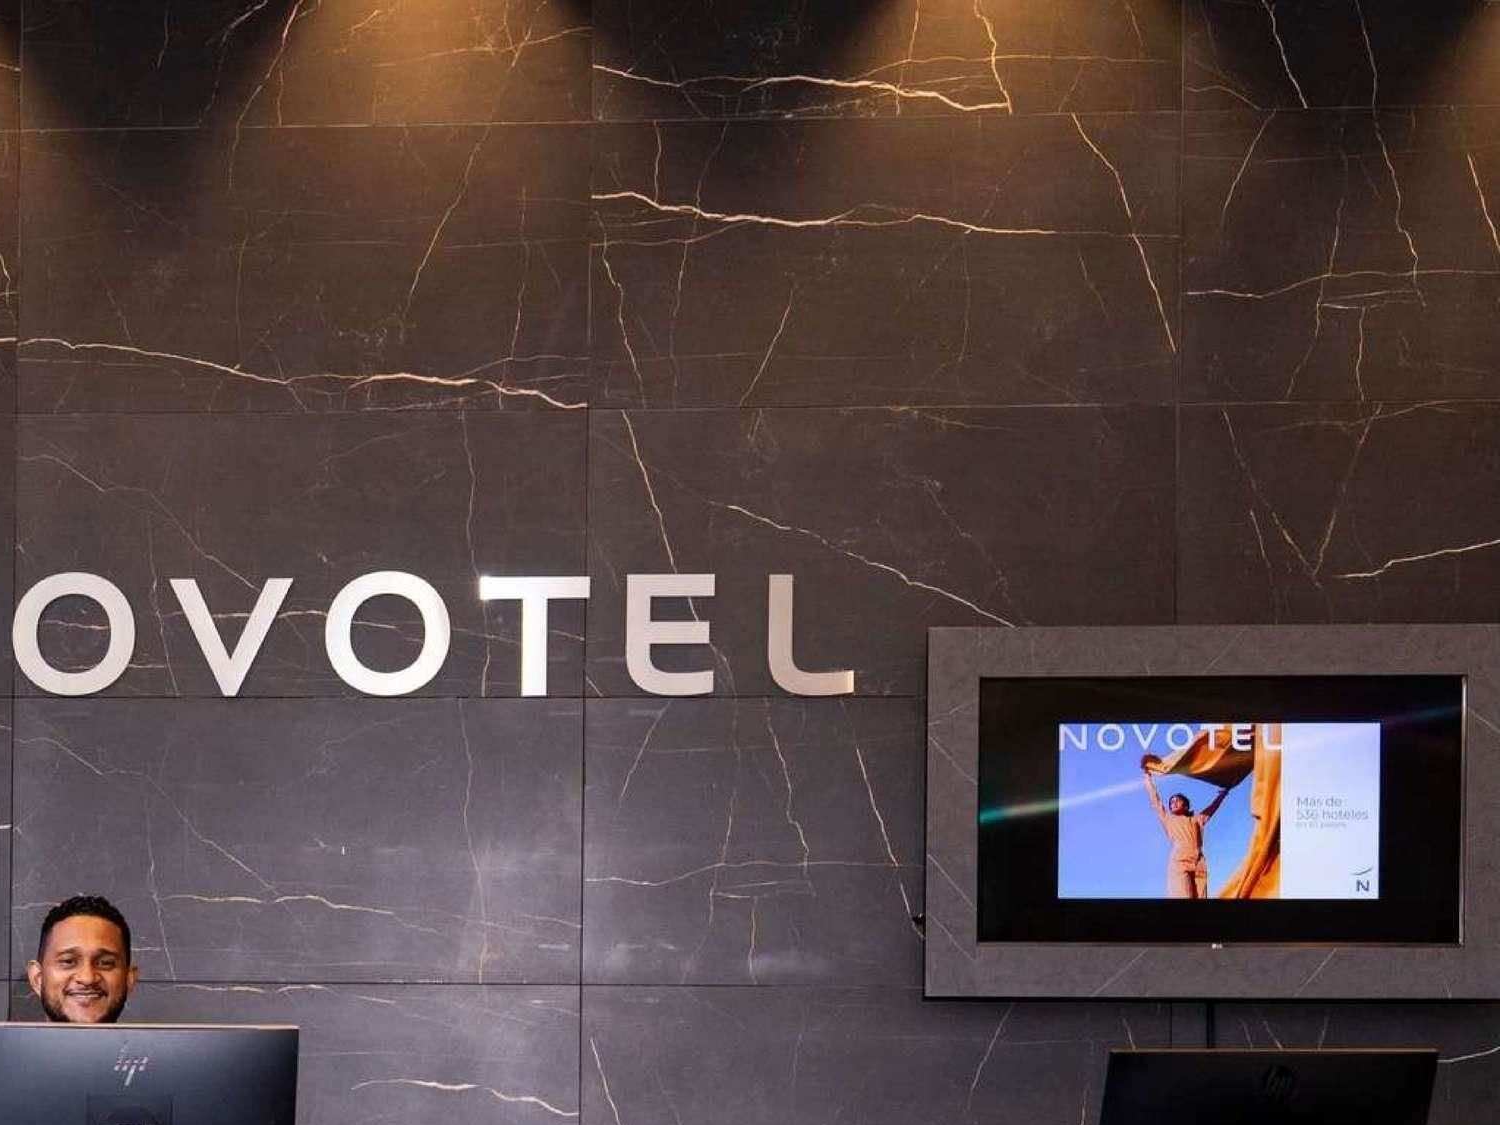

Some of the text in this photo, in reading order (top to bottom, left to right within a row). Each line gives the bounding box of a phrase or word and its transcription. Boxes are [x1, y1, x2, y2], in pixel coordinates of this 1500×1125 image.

[1059, 724, 1284, 750] NOVOTEL
[1322, 809, 1369, 820] hoteles
[1356, 880, 1370, 892] N
